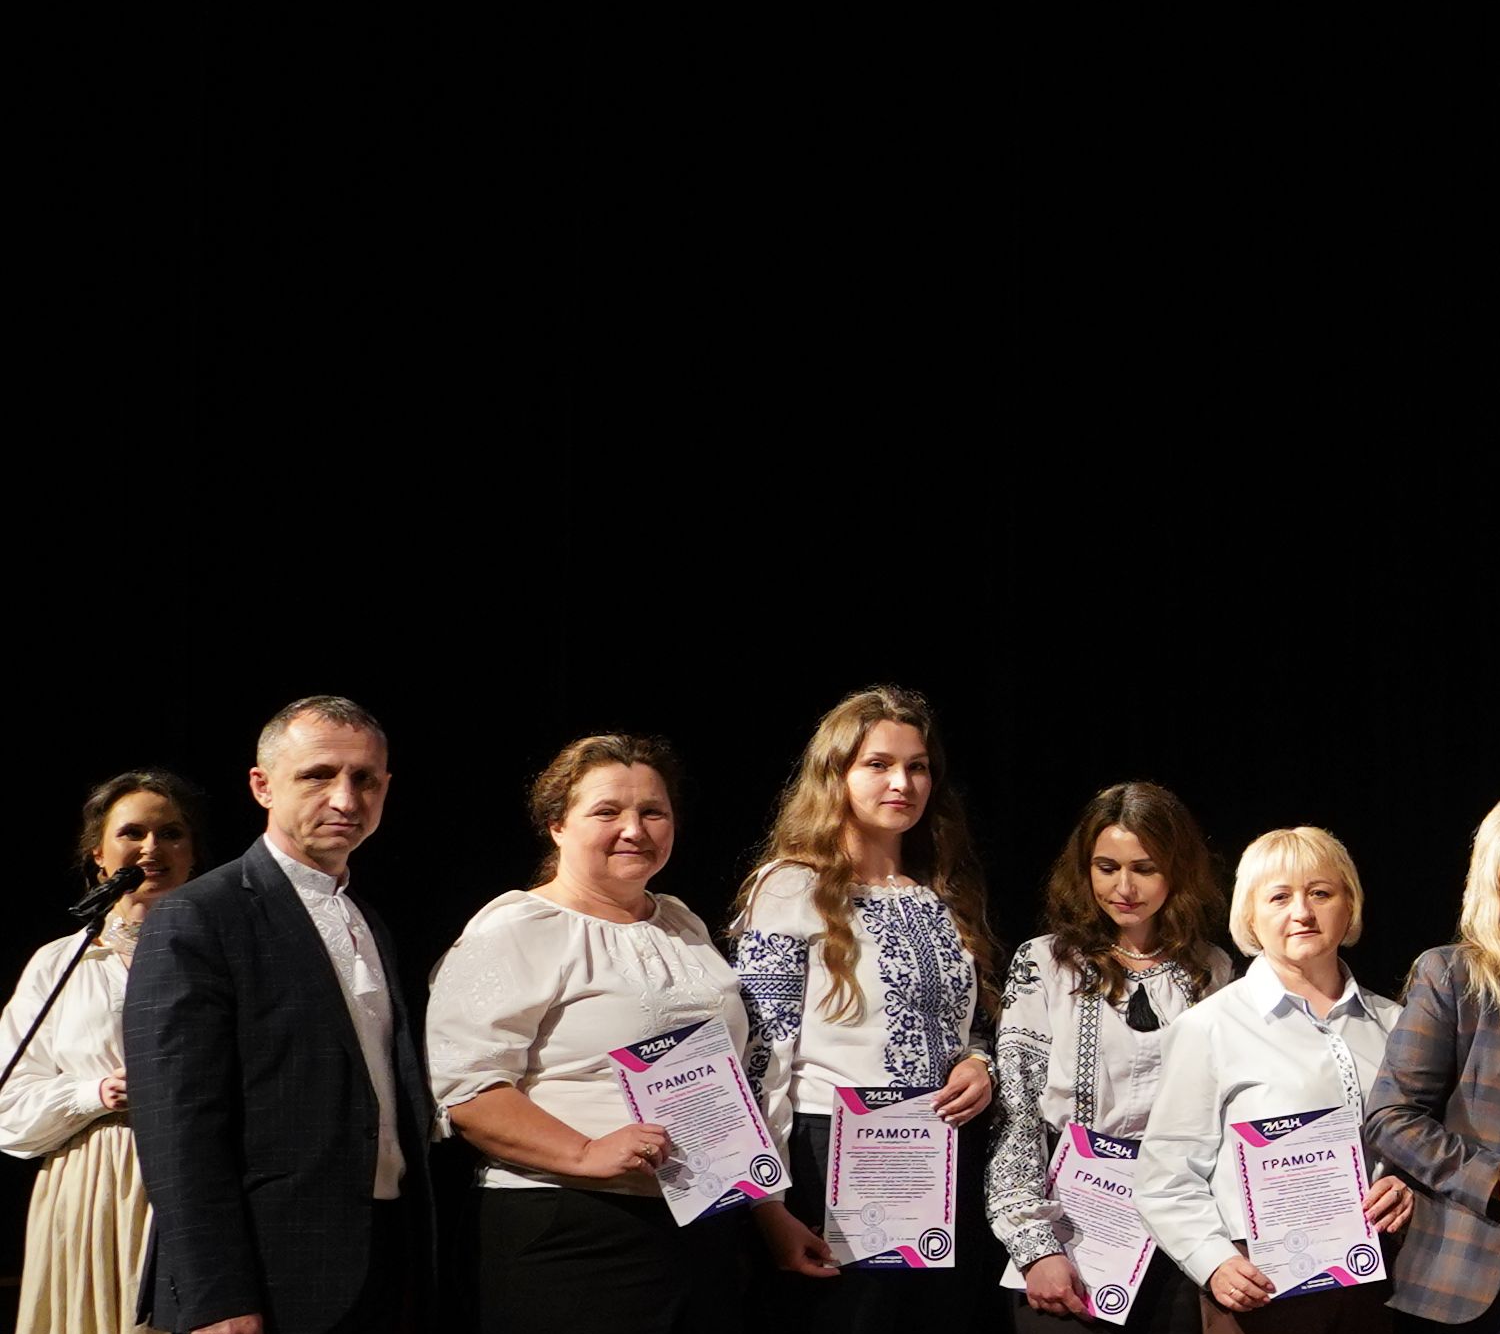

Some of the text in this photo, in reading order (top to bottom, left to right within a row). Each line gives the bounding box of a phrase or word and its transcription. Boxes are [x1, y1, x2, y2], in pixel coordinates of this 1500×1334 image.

[646, 1063, 717, 1095] ГРАМОТА
[857, 1128, 931, 1139] ГРАМОТА
[1262, 1149, 1337, 1171] ГРАМОТА
